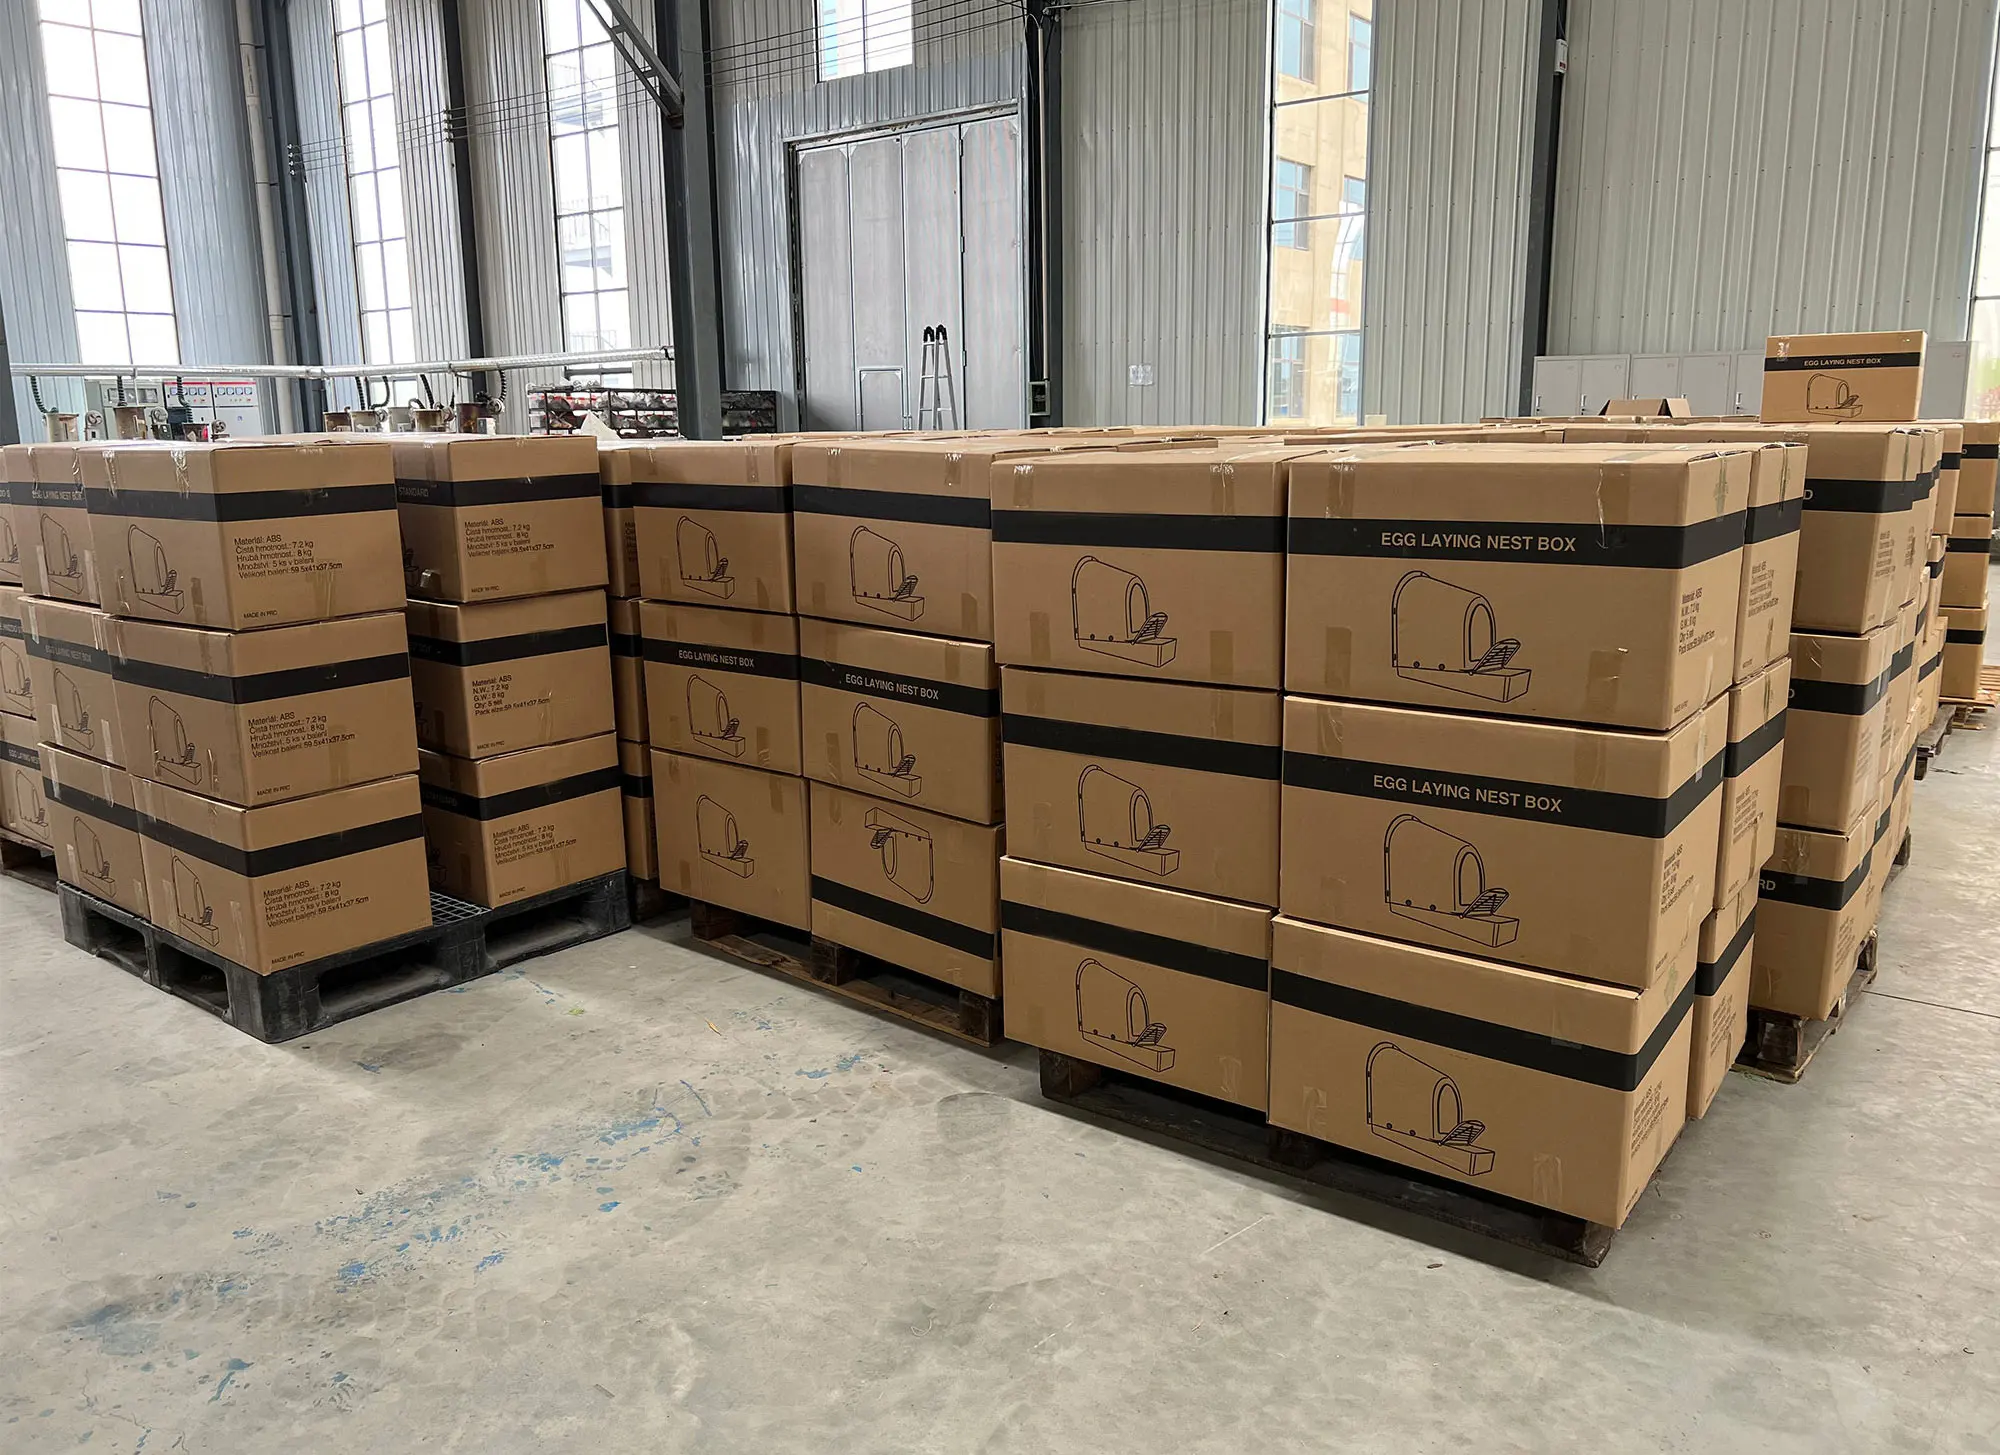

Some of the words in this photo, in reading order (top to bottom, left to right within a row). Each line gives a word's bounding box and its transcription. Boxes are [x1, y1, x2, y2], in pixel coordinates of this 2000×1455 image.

[266, 534, 282, 542] ABS
[1381, 532, 1416, 546] EGG
[1421, 533, 1481, 548] LAYING
[1487, 535, 1533, 550] NEST
[1537, 536, 1576, 552] BOX
[305, 541, 314, 549] kg
[678, 650, 693, 660] EGG
[694, 652, 719, 663] LAYING
[720, 654, 738, 665] NEST
[739, 657, 754, 667] BOX
[845, 674, 863, 686] EGG
[864, 678, 894, 691] LAYING
[896, 683, 919, 696] NEST
[920, 687, 939, 700] BOX
[280, 712, 295, 720] ABS
[306, 716, 317, 724] 7.2
[318, 715, 327, 723] kg
[1373, 774, 1407, 792] EGG
[1412, 779, 1470, 800] LAYING
[1476, 788, 1520, 806] NEST
[1525, 795, 1562, 813] BOX
[518, 824, 530, 832] ABS
[294, 880, 310, 890] ABS
[320, 883, 331, 891] 7.2
[332, 881, 341, 889] kg
